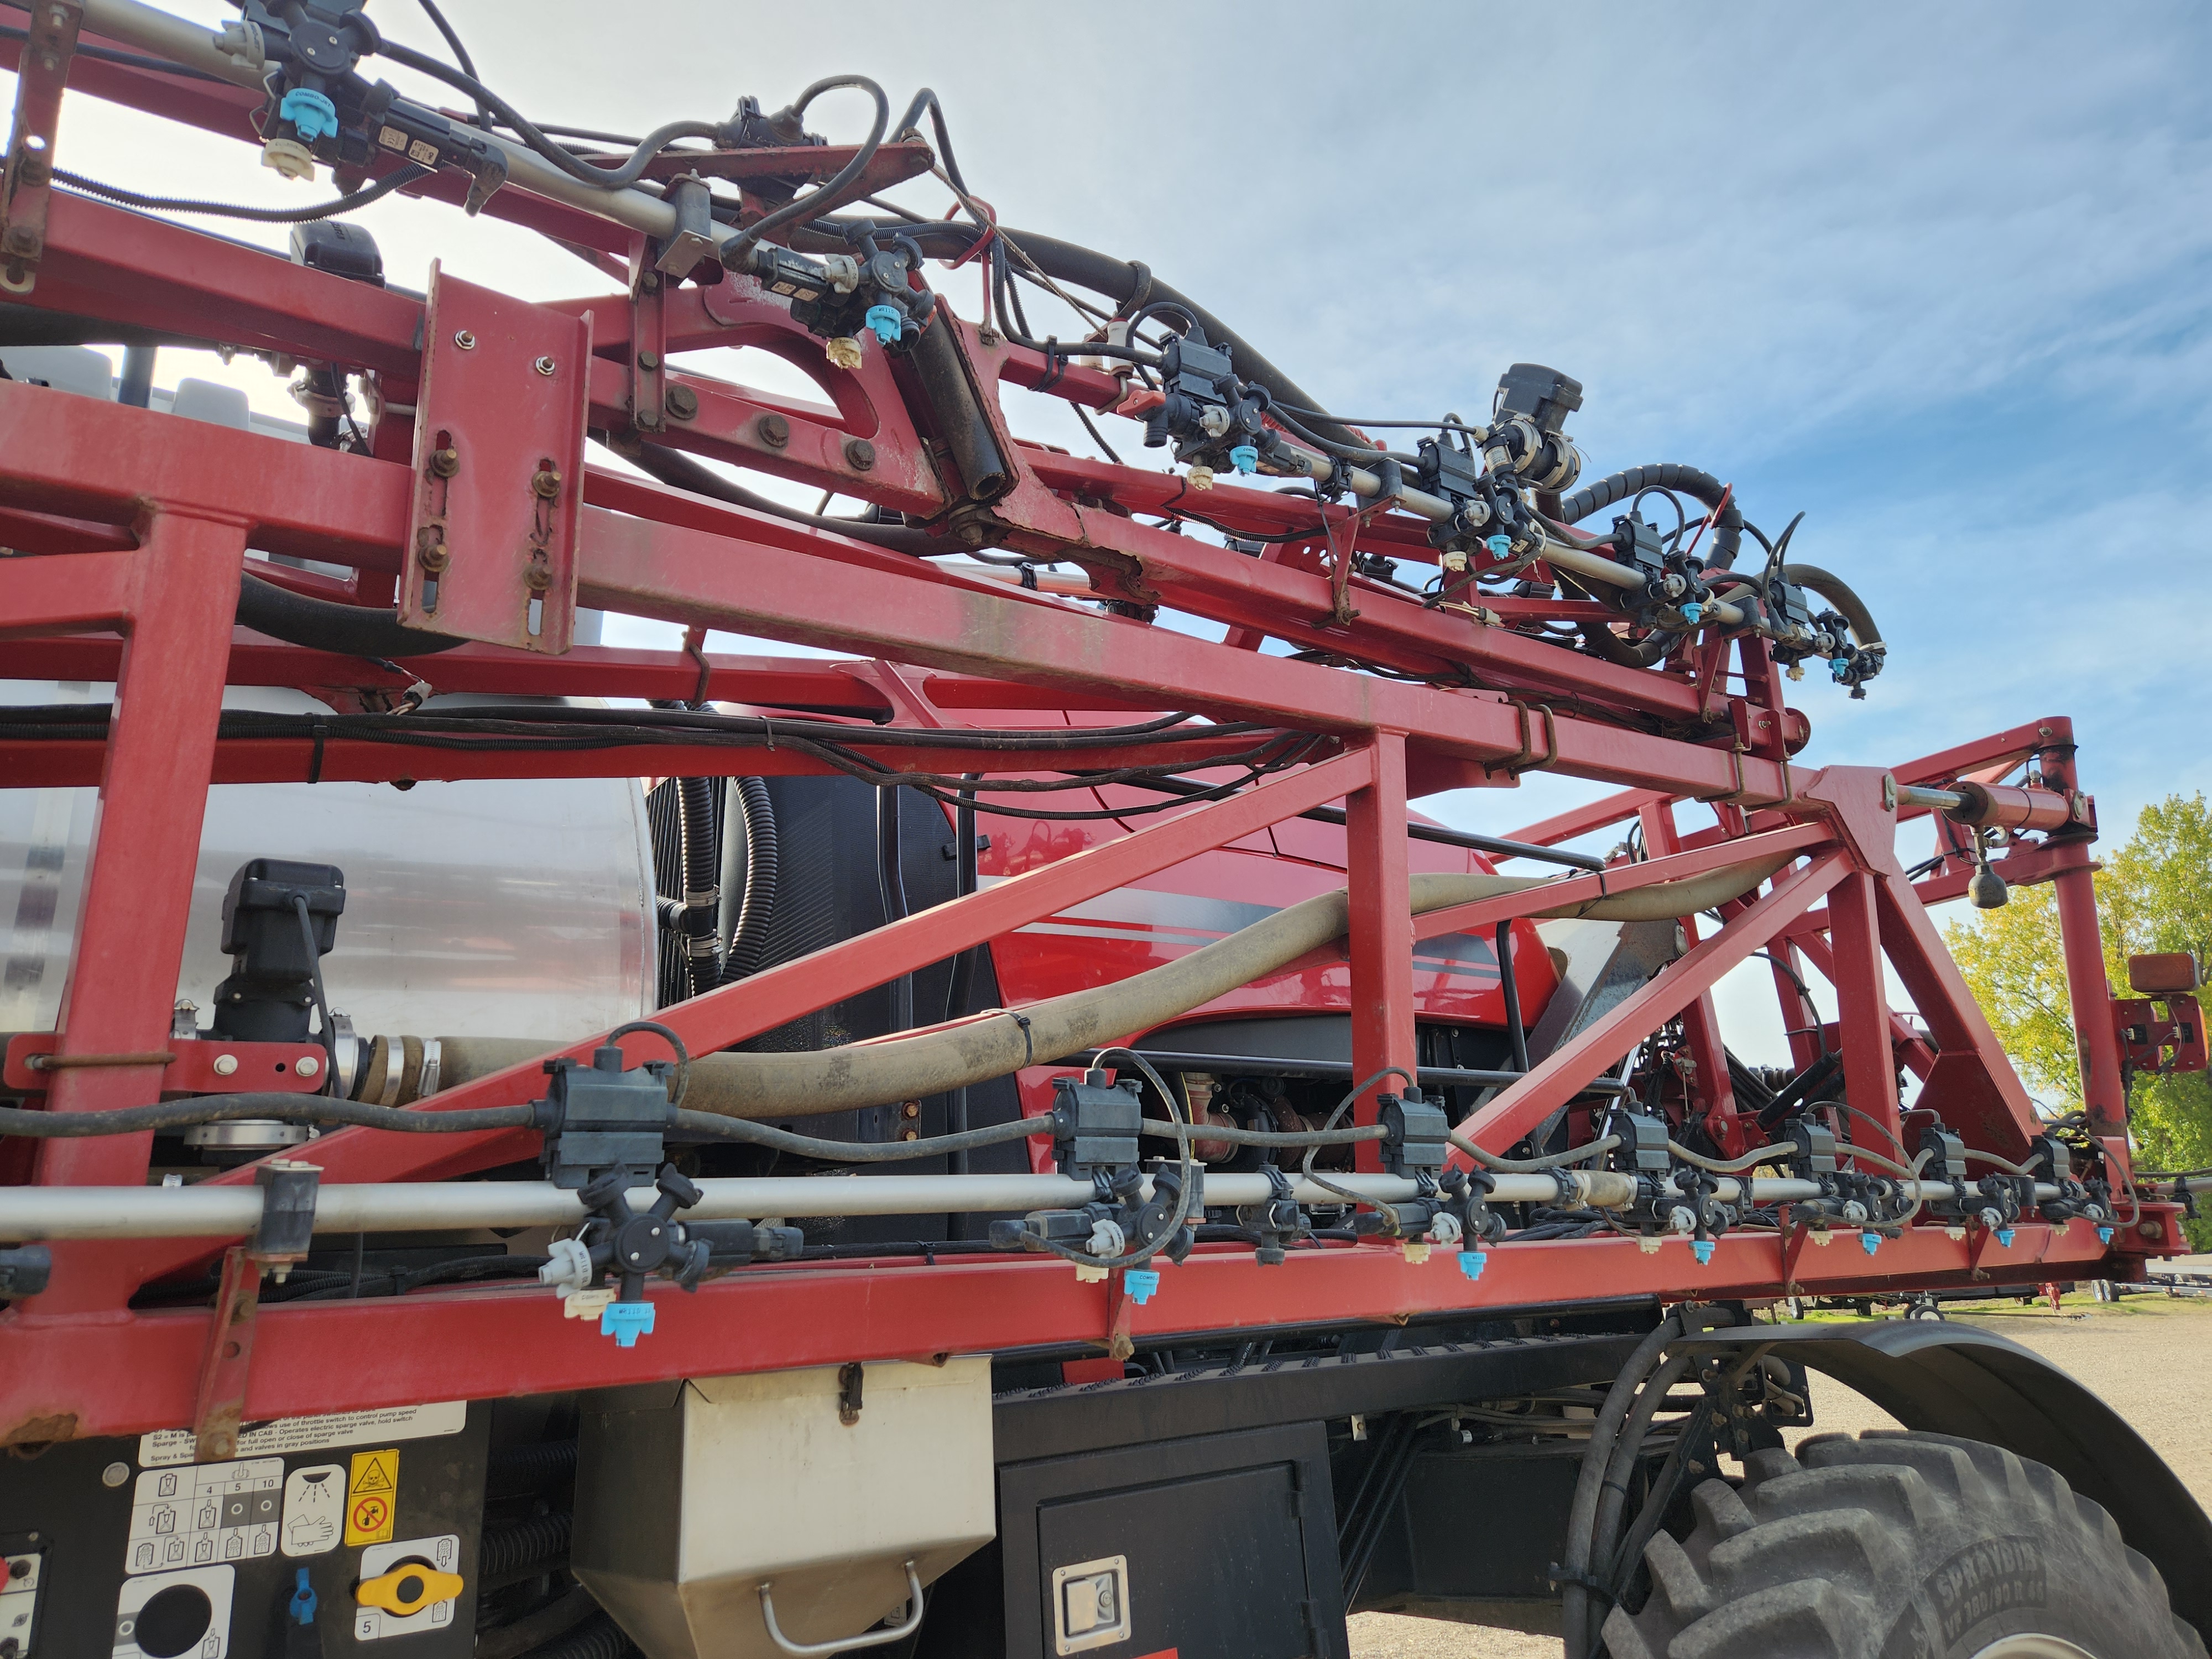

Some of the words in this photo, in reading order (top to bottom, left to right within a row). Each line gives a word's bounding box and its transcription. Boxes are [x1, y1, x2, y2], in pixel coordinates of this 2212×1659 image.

[326, 1415, 346, 1423] switch
[300, 1438, 330, 1446] positions
[235, 1483, 241, 1491] 5
[262, 1479, 274, 1488] 10
[207, 1486, 212, 1494] 4
[363, 1620, 371, 1634] 5
